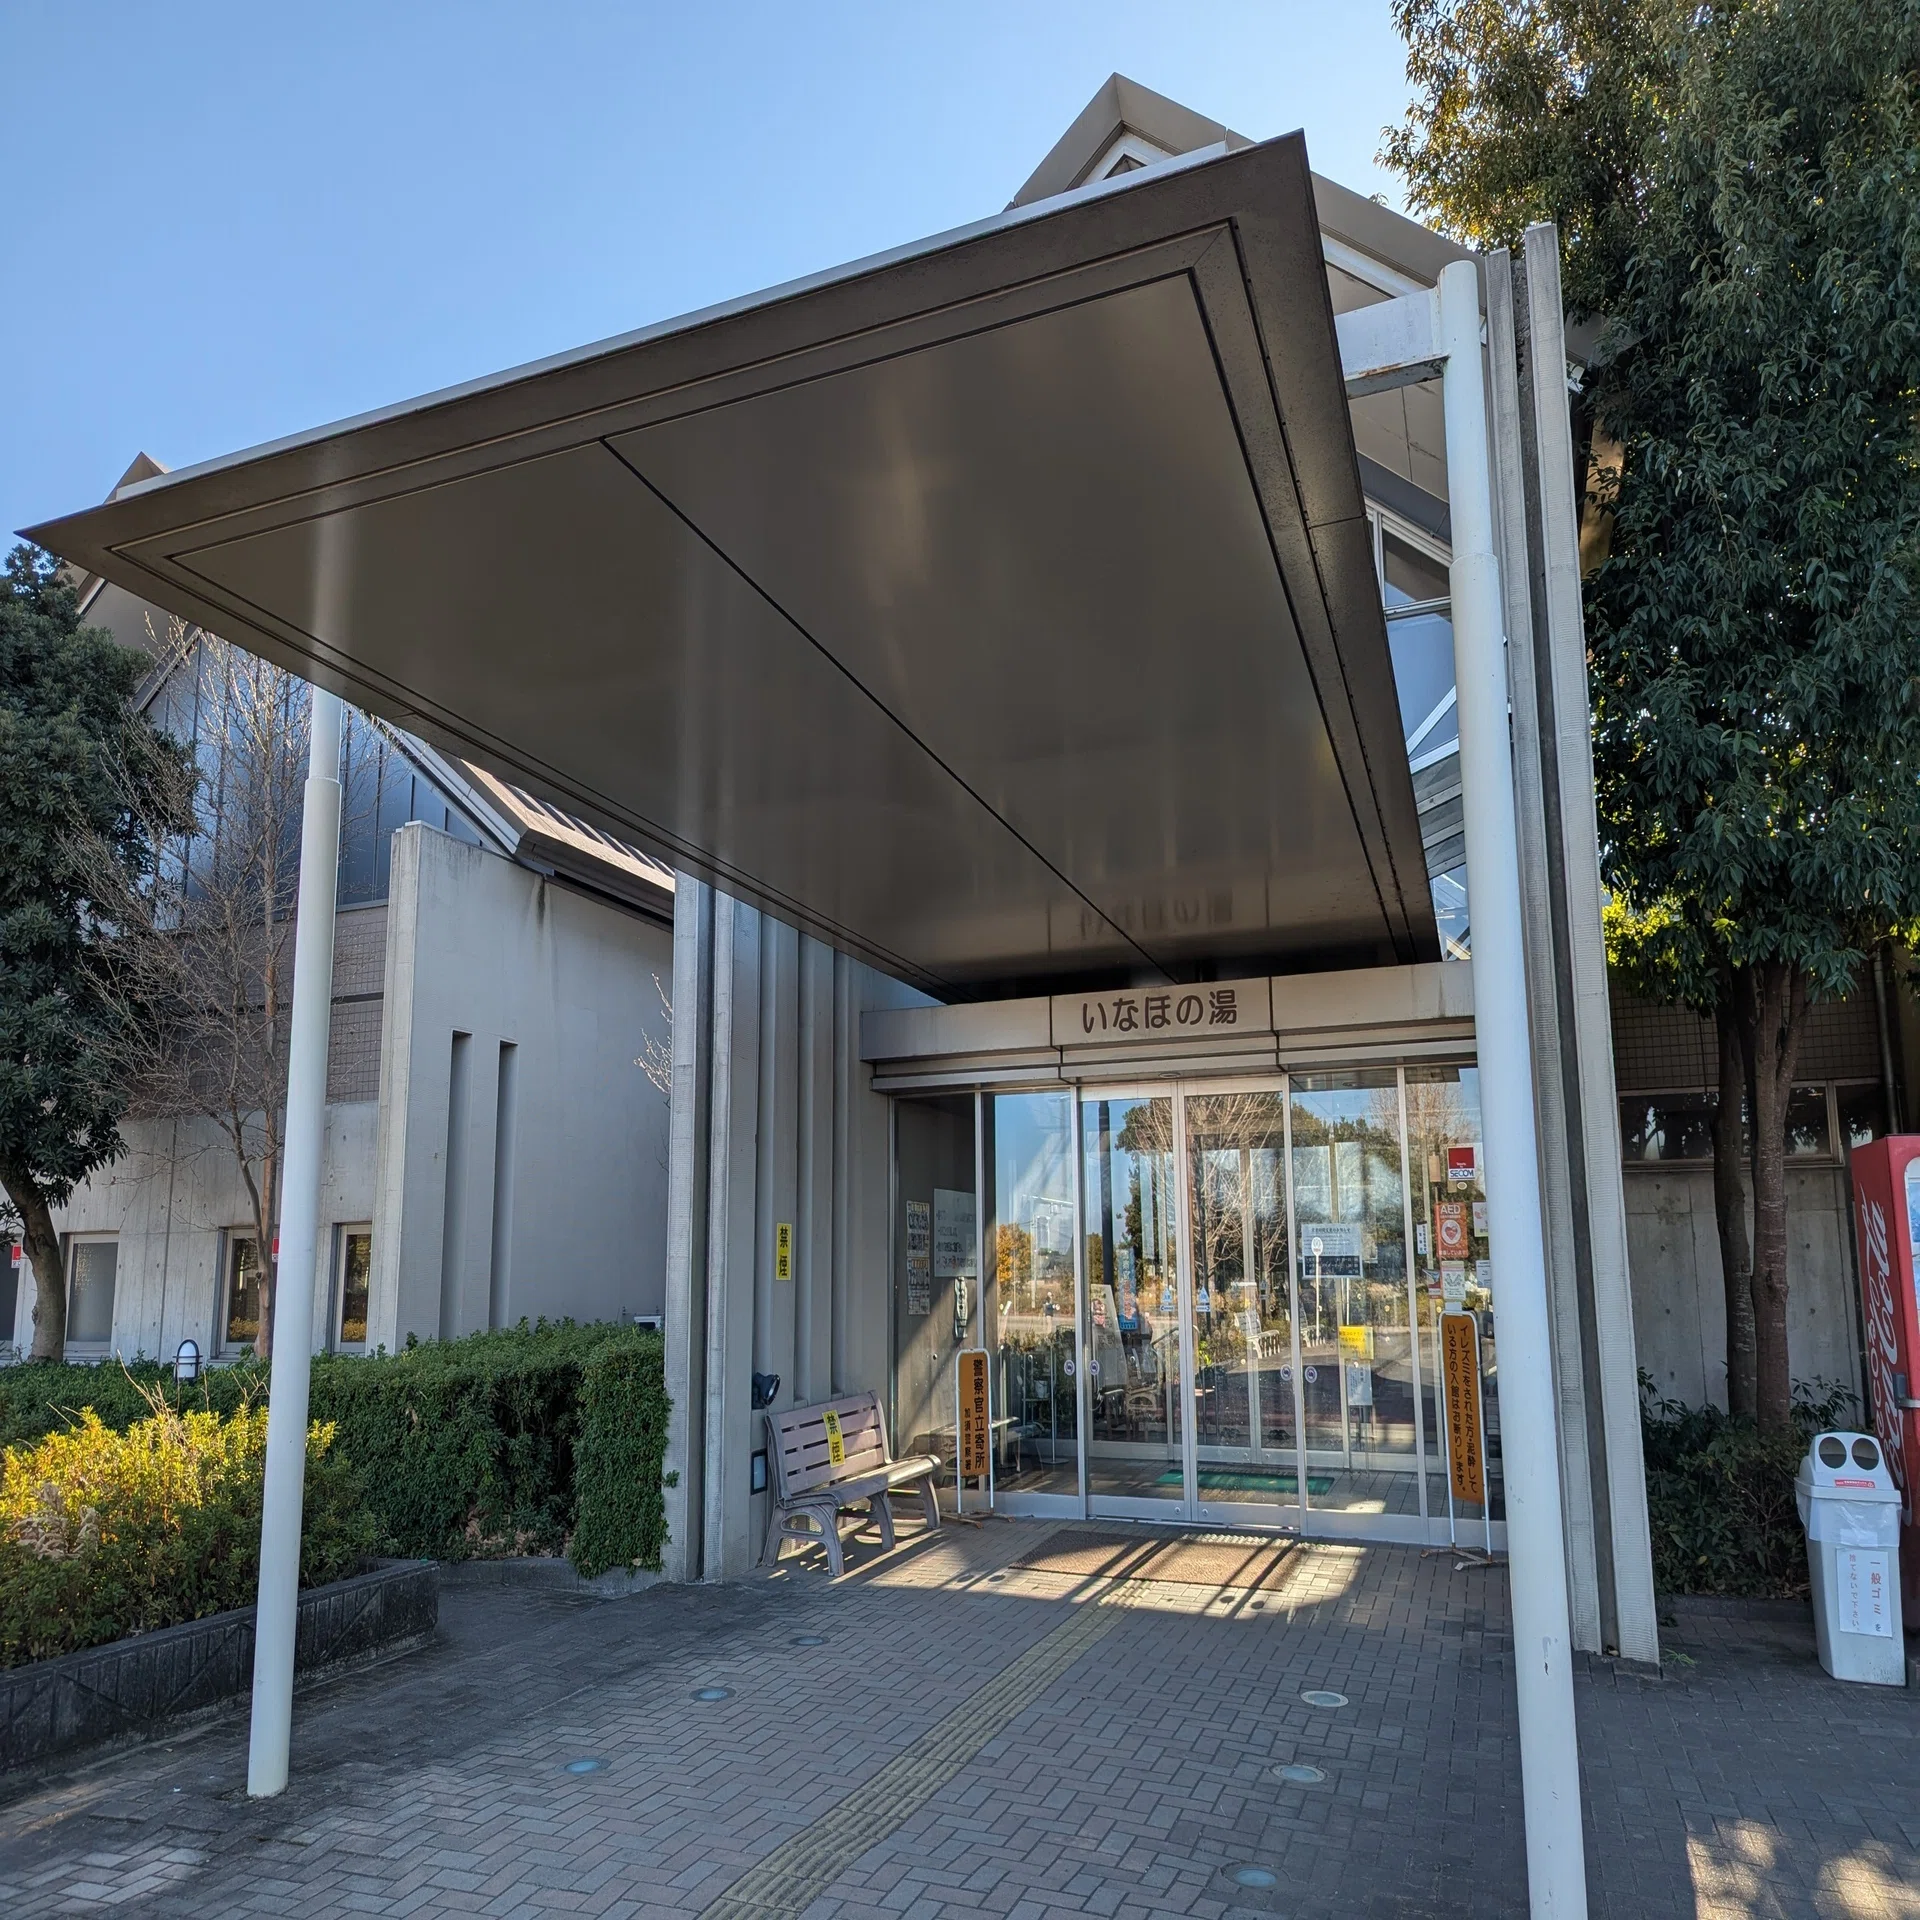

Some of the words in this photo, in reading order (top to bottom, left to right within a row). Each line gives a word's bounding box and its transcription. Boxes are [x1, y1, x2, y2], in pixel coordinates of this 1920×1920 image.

[1082, 989, 1238, 1034] いなほの湯
[1449, 1169, 1475, 1178] SECOM
[1440, 1204, 1461, 1215] AED
[779, 1226, 789, 1277] 禁煙
[1860, 1182, 1912, 1526] Coca-Cola
[826, 1414, 843, 1463] 禁煙
[973, 1359, 985, 1469] 警察官立寄所
